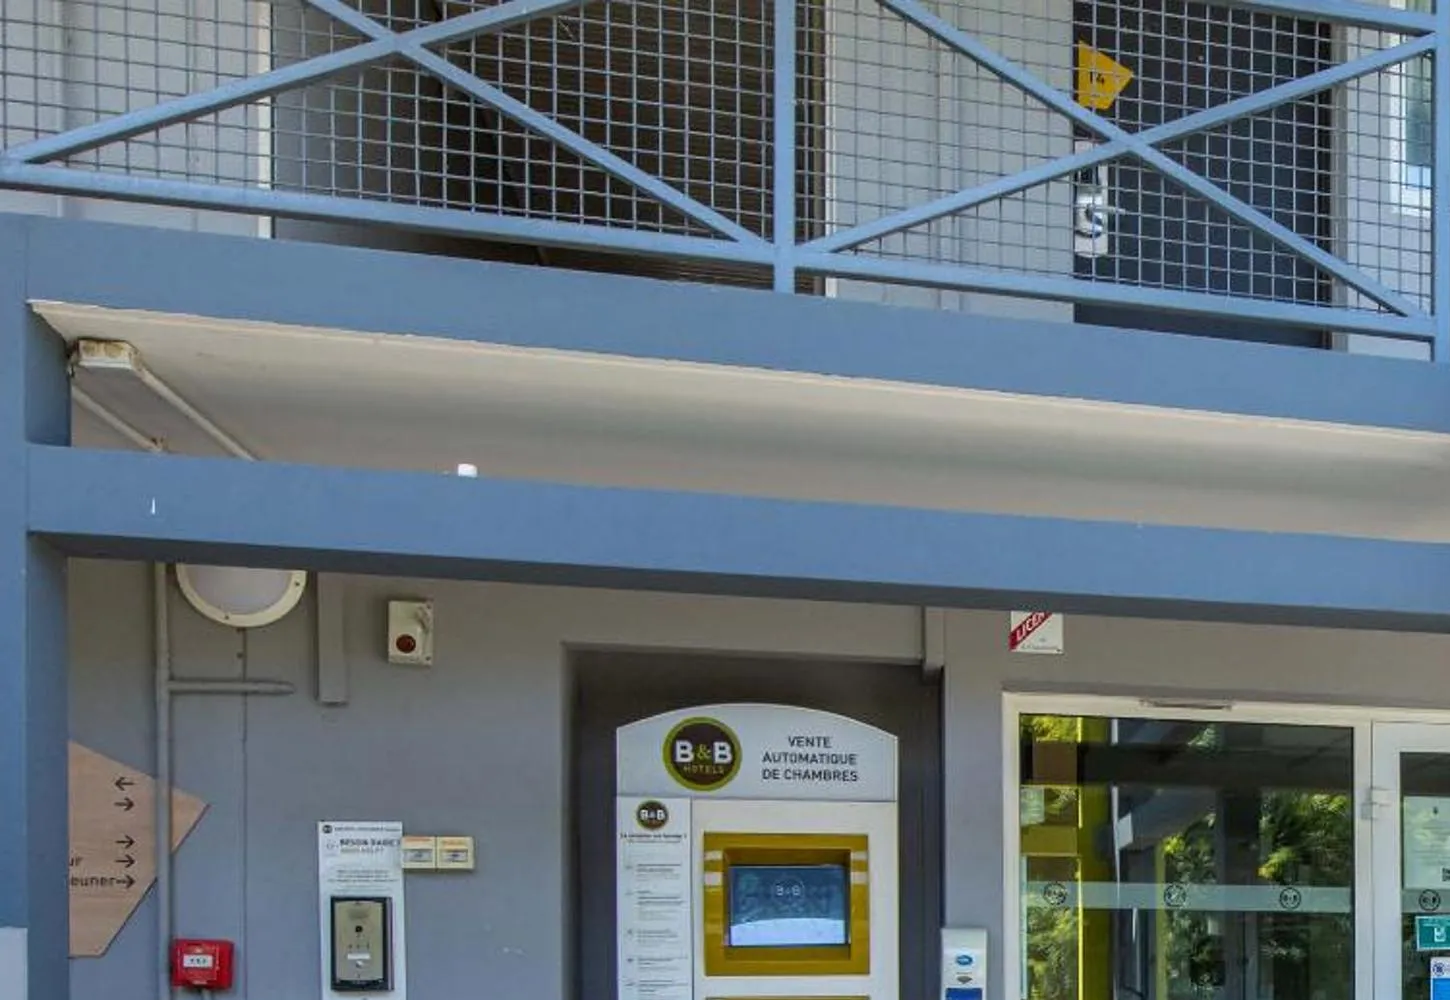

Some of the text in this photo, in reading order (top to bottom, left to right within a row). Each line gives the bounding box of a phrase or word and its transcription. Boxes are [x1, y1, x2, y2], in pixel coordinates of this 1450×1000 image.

[787, 736, 832, 748] VENTE
[675, 740, 733, 765] B&B
[761, 752, 858, 766] AUTOMATIQUE
[761, 769, 859, 783] DE CHAMBRES
